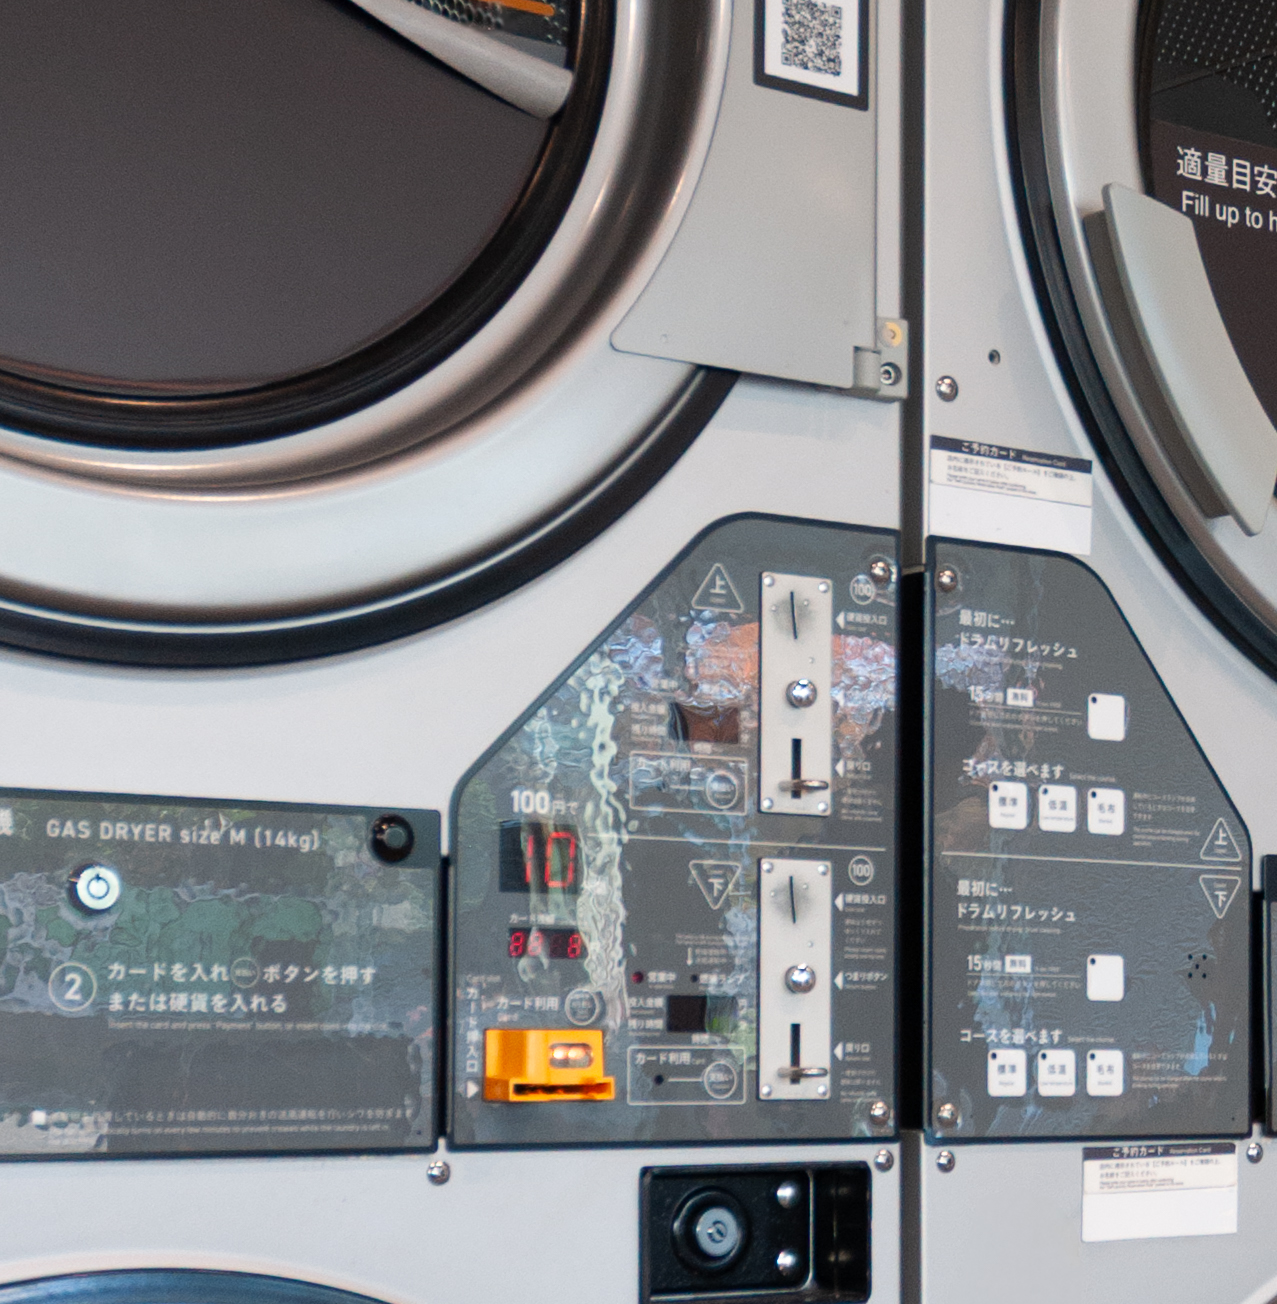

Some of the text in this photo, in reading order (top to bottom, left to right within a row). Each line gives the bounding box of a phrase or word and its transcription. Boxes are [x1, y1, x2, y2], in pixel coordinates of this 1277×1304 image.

[1182, 190, 1209, 218] Fill
[1216, 204, 1240, 228] up
[1245, 206, 1263, 229] to
[710, 575, 726, 594] 上
[853, 583, 871, 596] 100
[959, 631, 1078, 659] ドラムリフレッシュ
[962, 758, 1065, 780] コースを選べます
[1097, 803, 1116, 814] 毛布
[46, 818, 319, 853] GAS DRYER size M (14kg)
[1214, 828, 1228, 845] 上
[524, 832, 576, 888] 10
[852, 863, 869, 877] 100
[708, 878, 724, 897] 下
[1213, 891, 1227, 908] 下
[957, 902, 1076, 922] ドラムリフレッシュ
[108, 961, 230, 983] カードを入れ
[263, 963, 376, 985] ボタンを押す
[64, 973, 82, 1000] 2
[108, 991, 288, 1014] または硬貨を入れる
[498, 996, 560, 1012] カード利用
[960, 1028, 1063, 1044] コースを選べます
[635, 1051, 691, 1065] カード利用
[1097, 1064, 1115, 1075] 毛布
